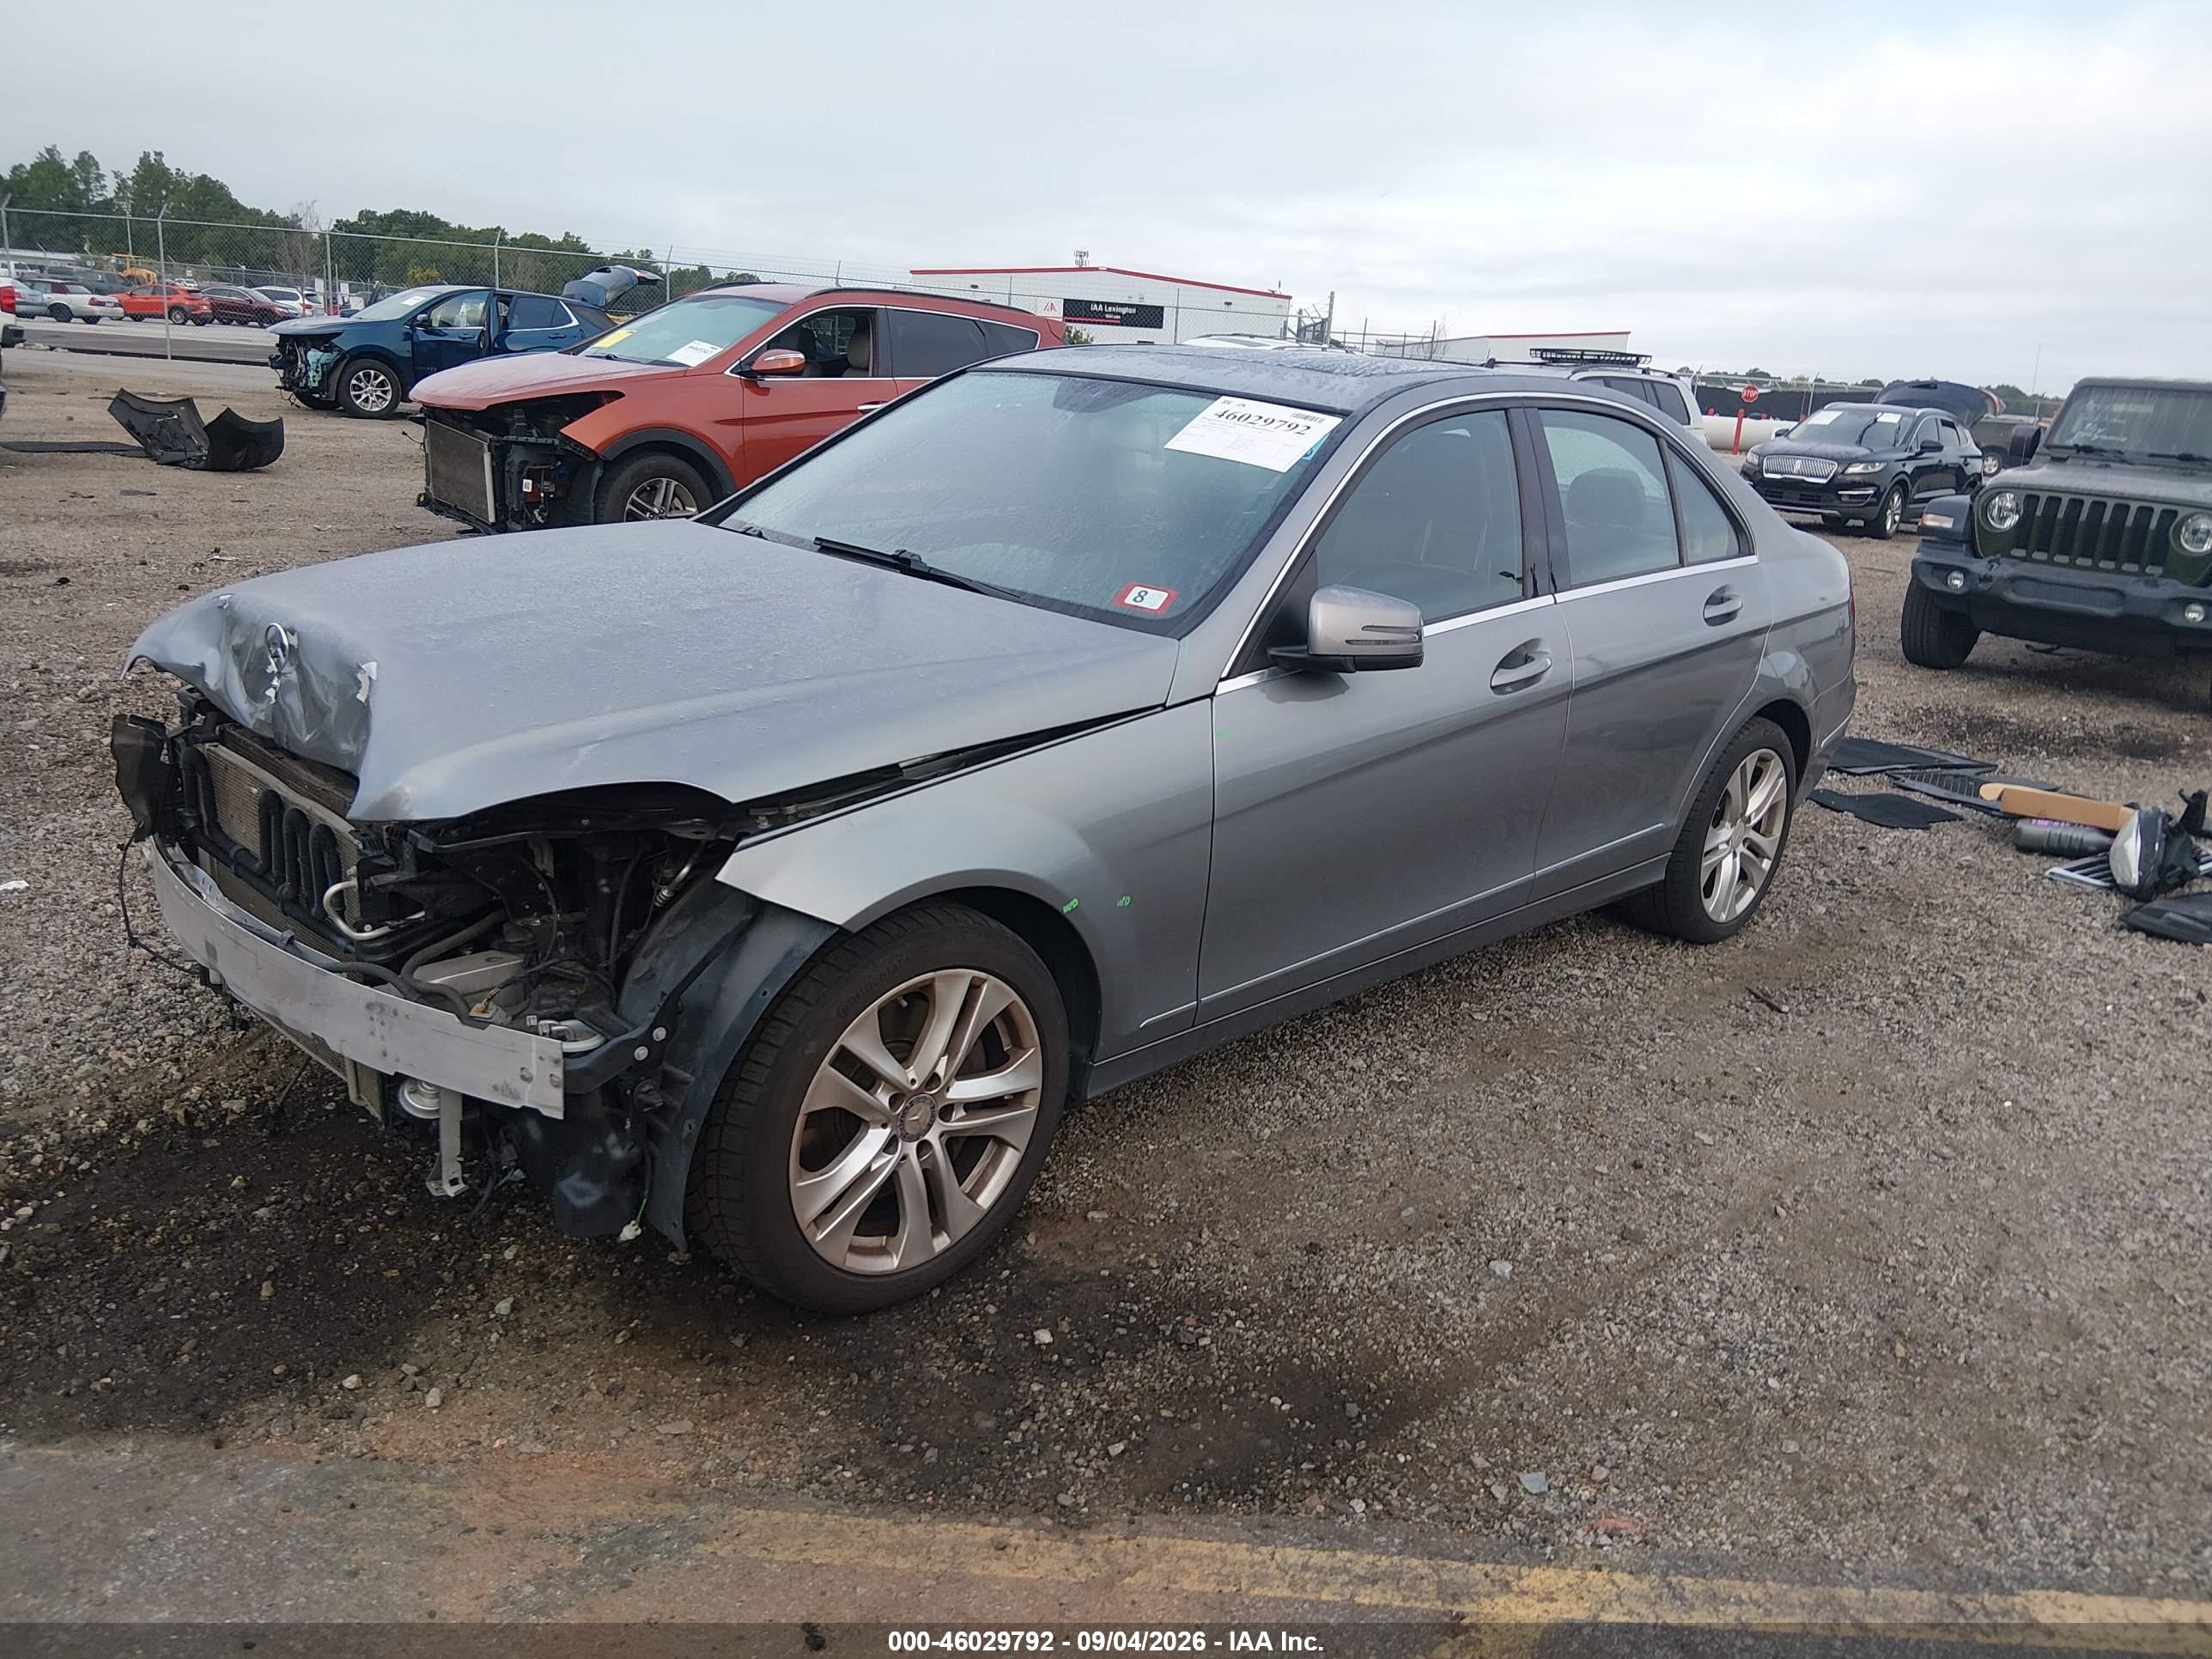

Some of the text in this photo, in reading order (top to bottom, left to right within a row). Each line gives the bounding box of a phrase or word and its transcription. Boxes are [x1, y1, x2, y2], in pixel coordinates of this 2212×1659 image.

[1091, 303, 1136, 314] IAA Lexington
[1743, 389, 1758, 398] STOP
[1213, 409, 1311, 435] 46029792
[1133, 590, 1148, 603] 8
